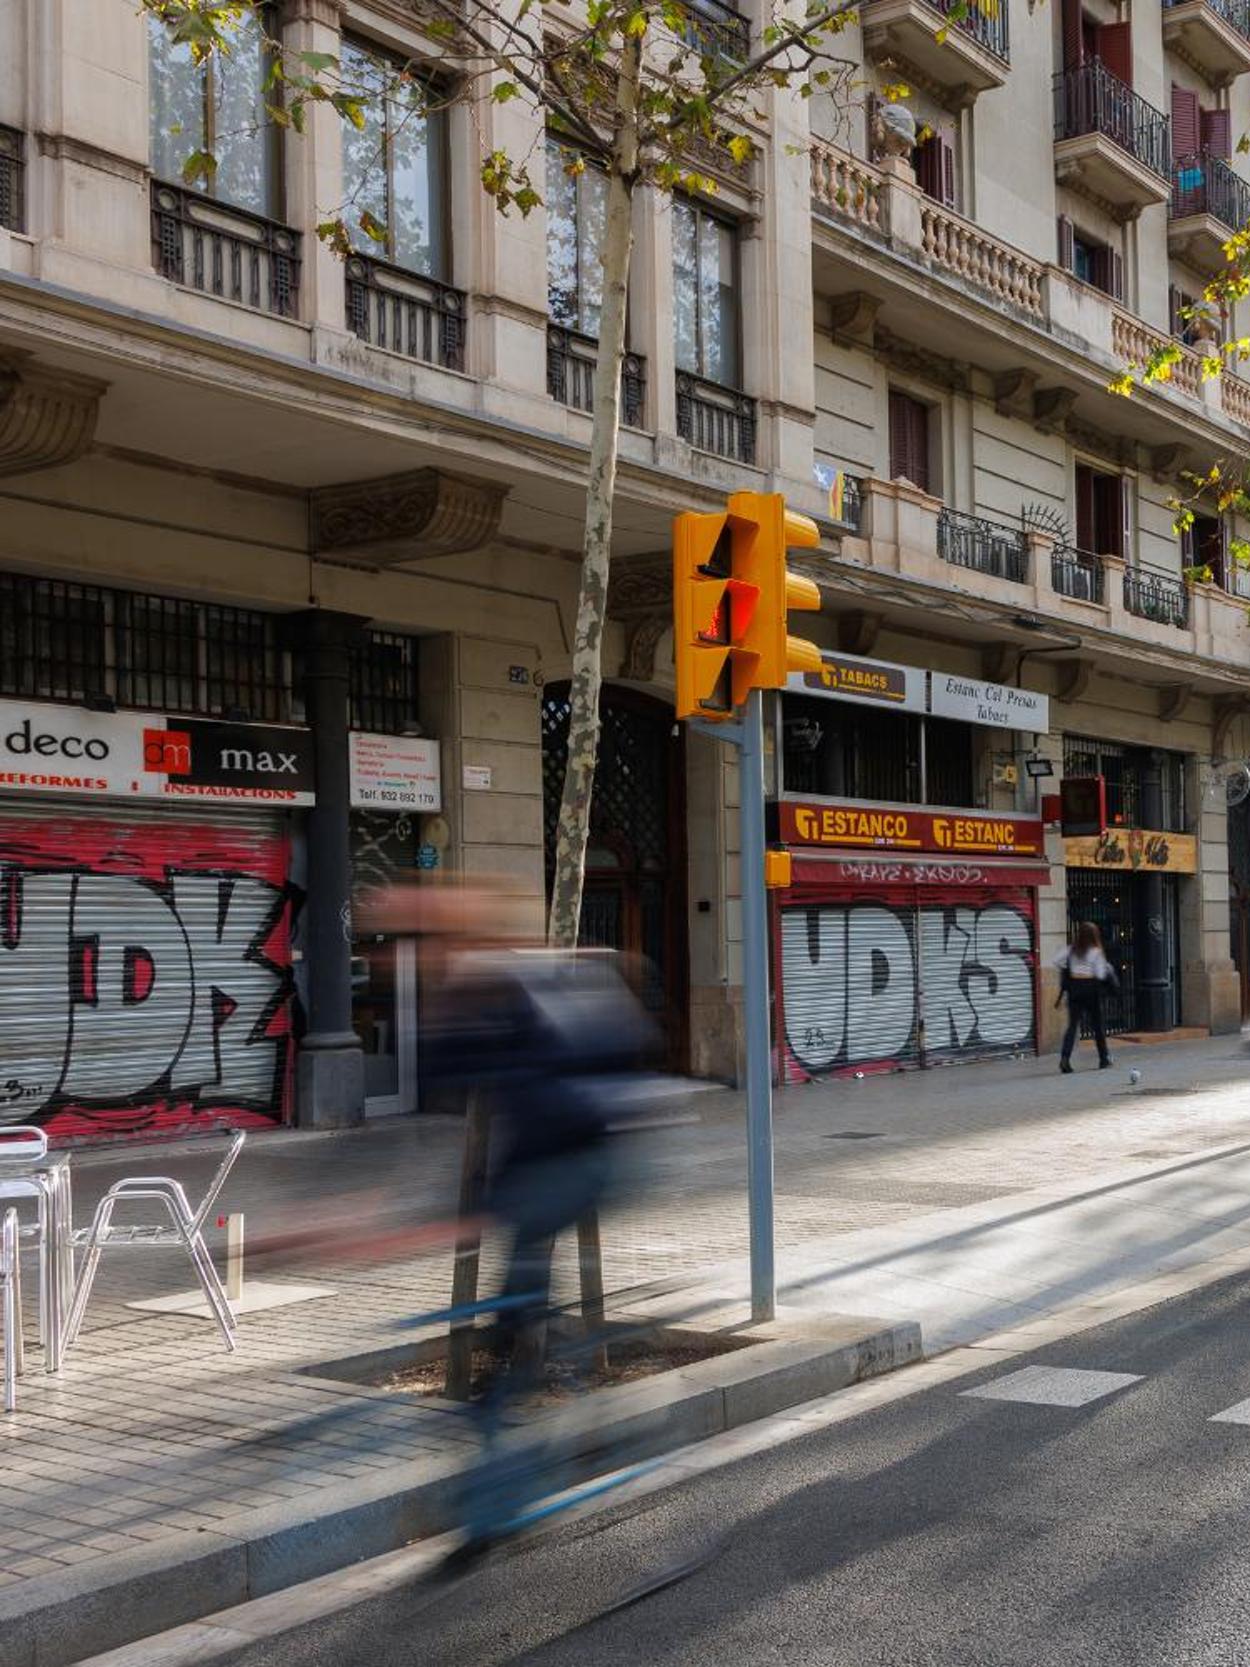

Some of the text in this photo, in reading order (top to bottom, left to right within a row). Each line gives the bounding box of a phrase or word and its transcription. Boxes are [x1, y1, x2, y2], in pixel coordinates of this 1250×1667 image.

[839, 667, 889, 690] TABACS
[945, 678, 980, 699] Estanc
[5, 719, 109, 760] deco
[219, 748, 299, 775] max
[821, 810, 908, 837] ESTANCO
[954, 820, 1015, 844] ESTANC
